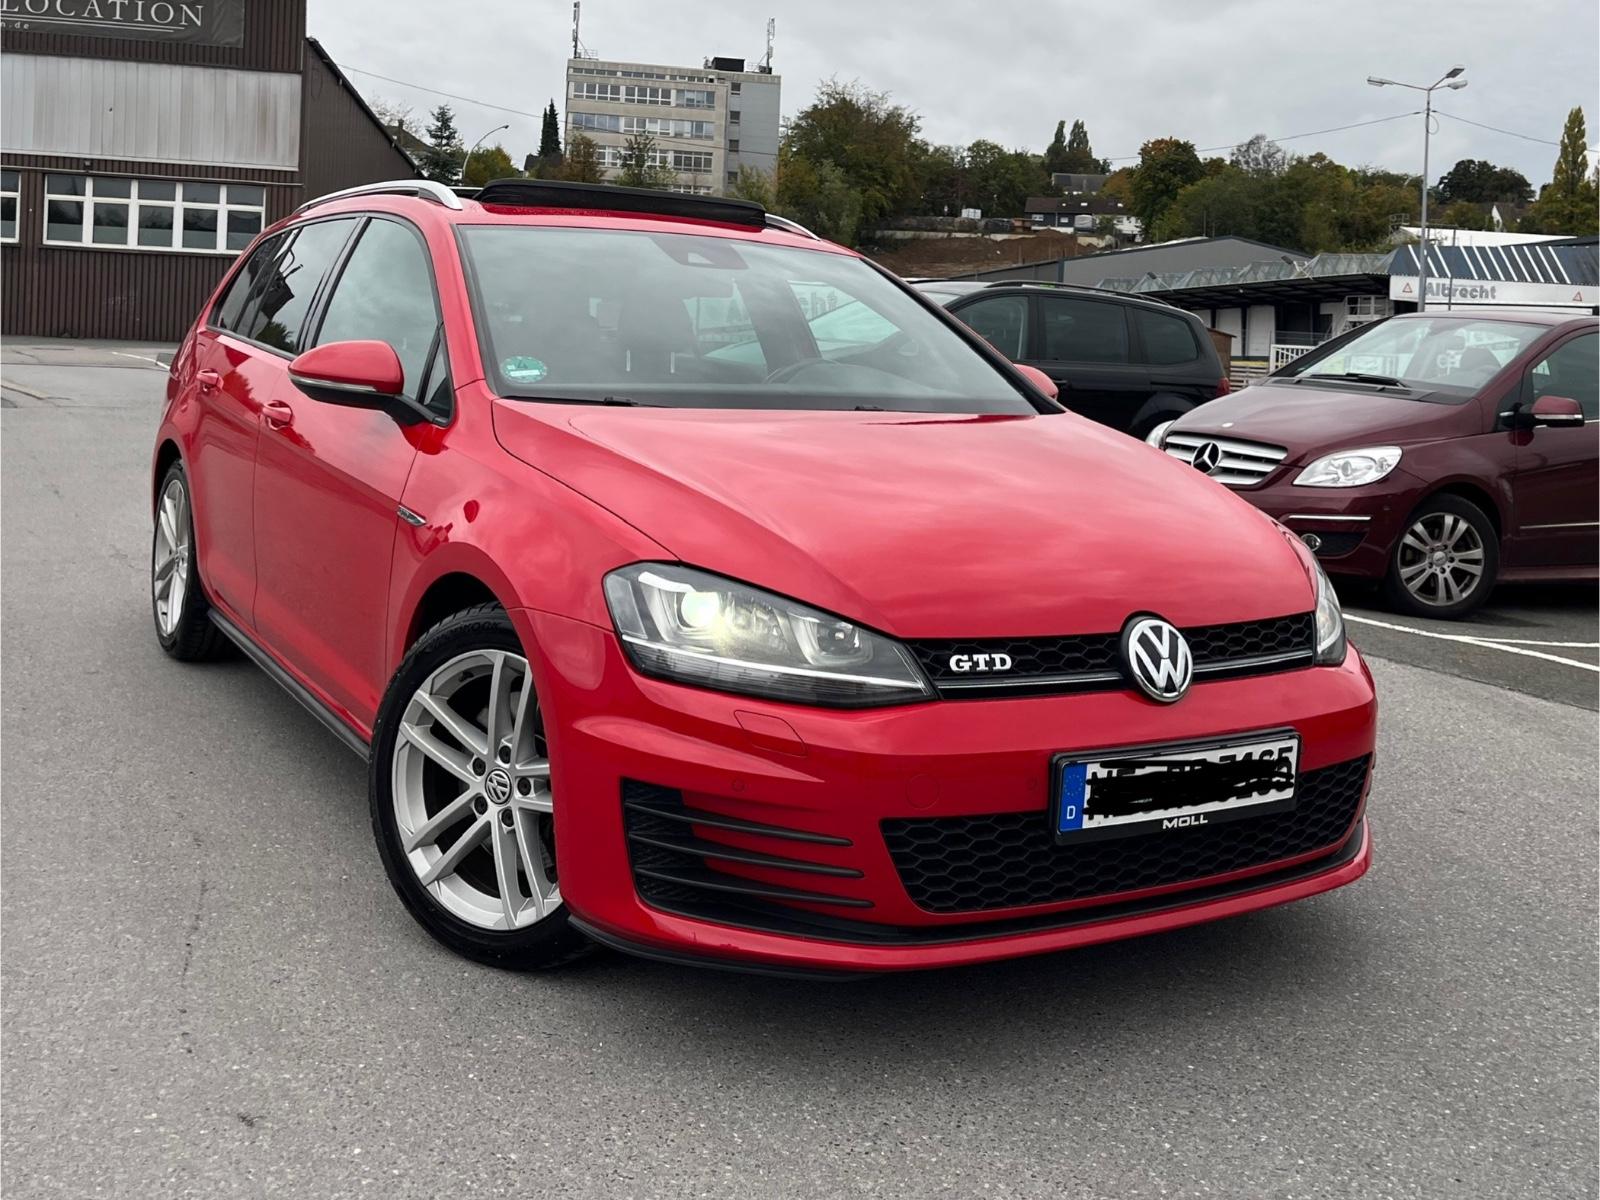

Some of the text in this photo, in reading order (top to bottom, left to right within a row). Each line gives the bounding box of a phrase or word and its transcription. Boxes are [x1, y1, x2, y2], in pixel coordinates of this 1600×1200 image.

[1425, 282, 1496, 299] Albrecht
[949, 653, 1012, 673] GTD
[1066, 805, 1076, 820] D
[1162, 814, 1208, 830] MOLL
